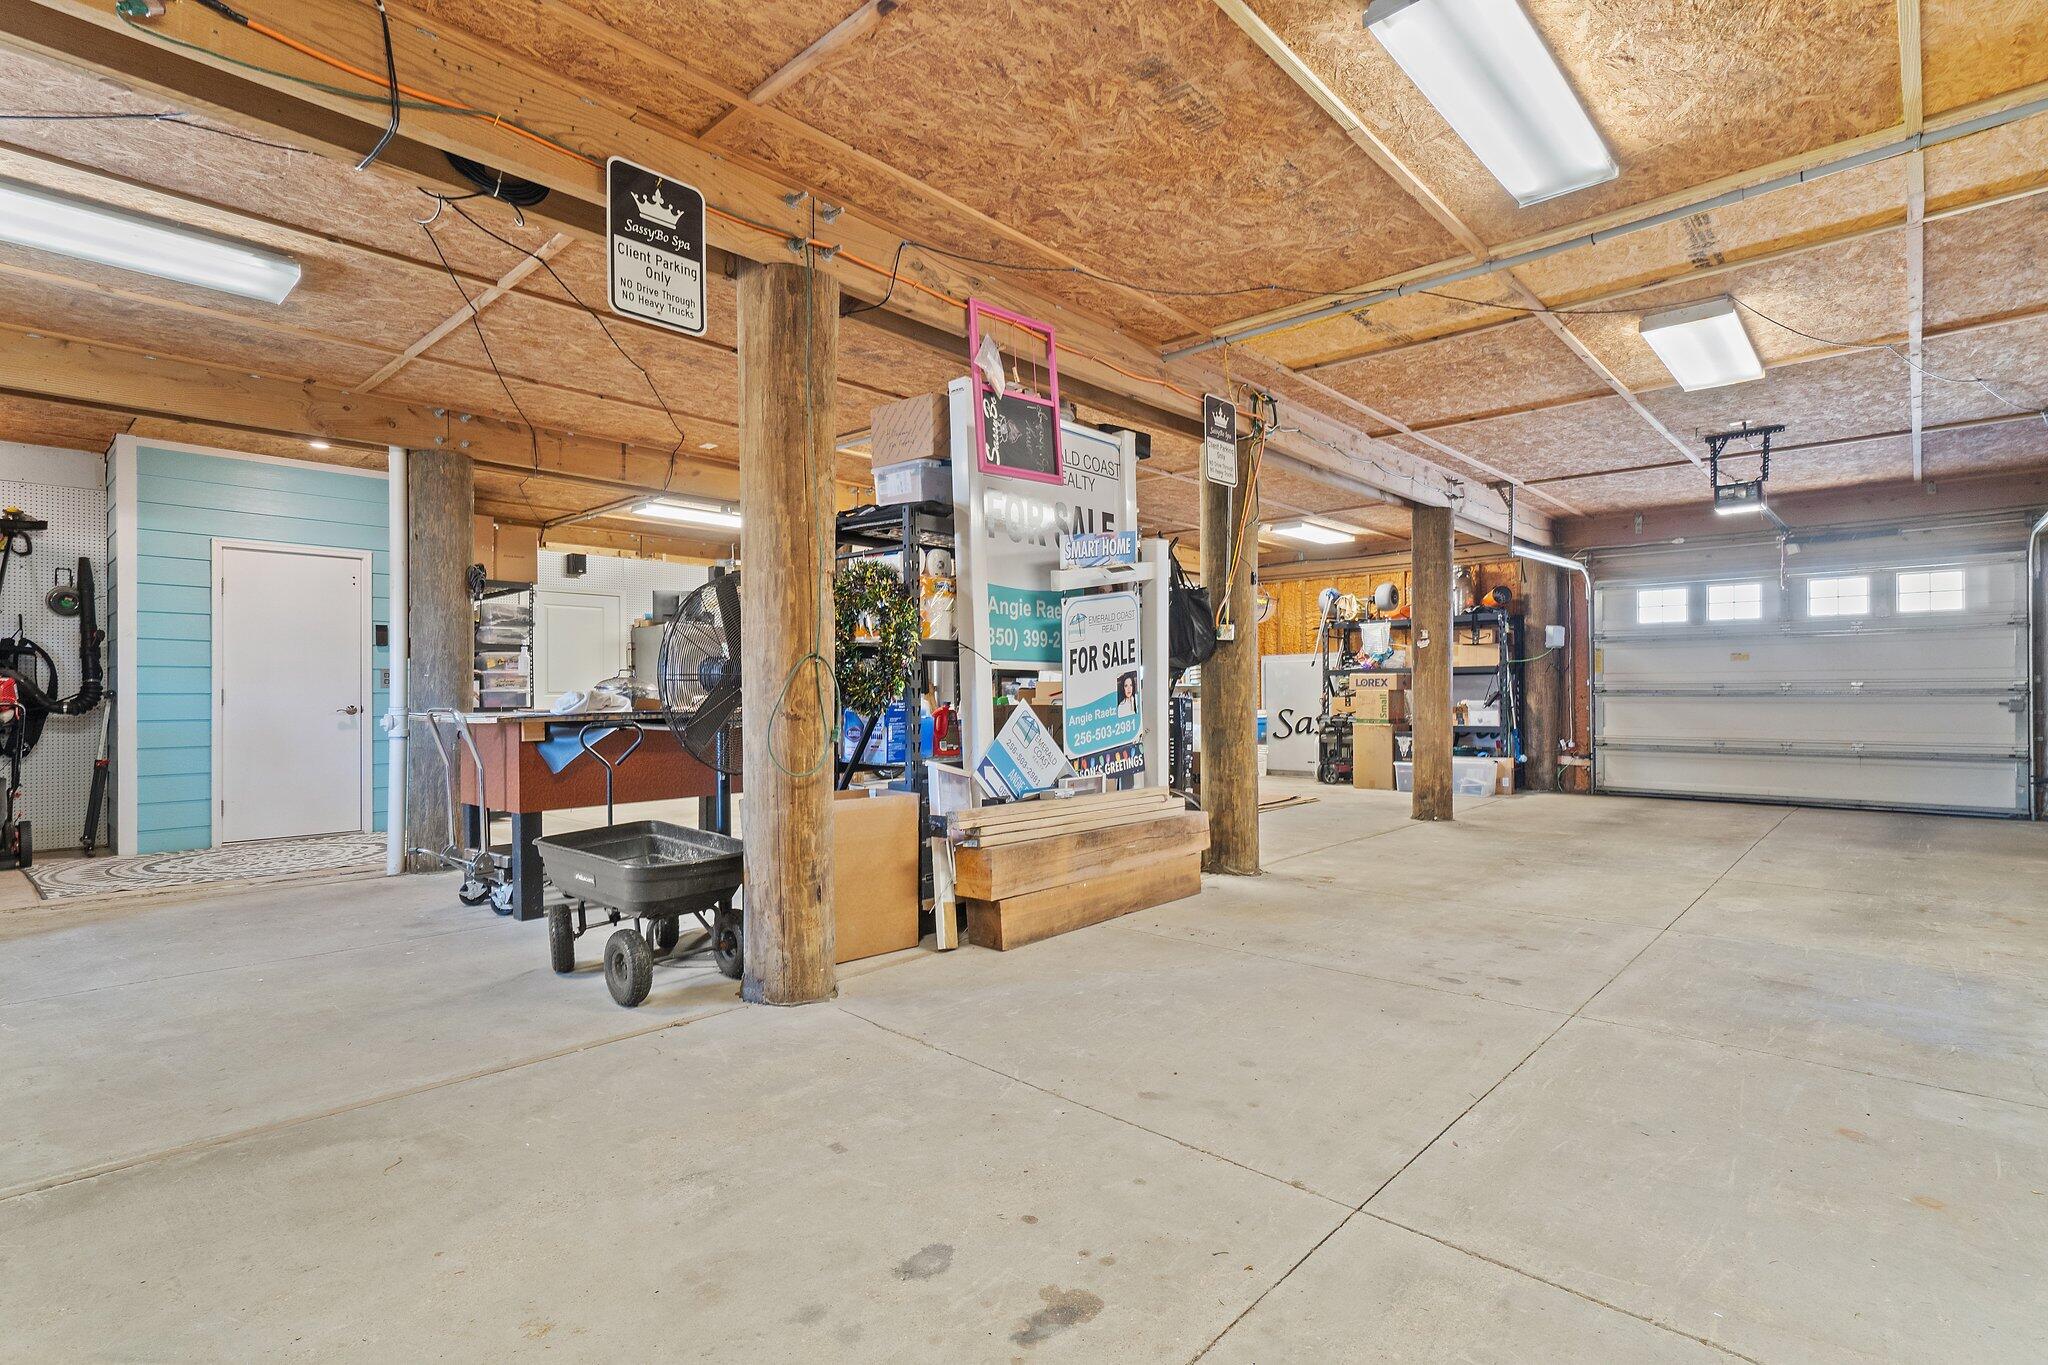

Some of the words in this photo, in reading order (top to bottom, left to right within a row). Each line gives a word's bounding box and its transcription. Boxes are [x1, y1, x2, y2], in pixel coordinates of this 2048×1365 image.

[624, 219, 669, 242] SassyBo
[671, 235, 691, 251] Spa
[617, 242, 651, 263] Client
[655, 254, 697, 282] Parking
[645, 266, 671, 286] Only
[620, 277, 633, 289] NO
[636, 282, 659, 297] Drive
[661, 290, 696, 309] Through
[622, 290, 635, 302] NO
[638, 294, 665, 312] Heavy
[667, 303, 695, 319] Trucks
[1083, 454, 1120, 478] COAST
[985, 489, 1048, 547] FOR
[1055, 501, 1115, 548] SALE
[1065, 540, 1100, 560] SMART
[1102, 537, 1131, 556] HOME
[988, 596, 1032, 620] Angie
[1088, 612, 1116, 624] EMERALD
[1116, 610, 1135, 620] COAST
[1101, 623, 1123, 633] REALTY
[1069, 645, 1098, 676] FOR
[1102, 638, 1136, 669] SALE
[1355, 678, 1388, 687] LOREX
[1068, 711, 1093, 726] Angie
[1094, 707, 1117, 720] Raetz
[1379, 694, 1387, 718] Small
[1073, 719, 1136, 747] 256-503-2981
[1272, 708, 1320, 739] Sa
[1033, 746, 1051, 768] COAST
[1034, 734, 1058, 766] EMERALD
[1104, 754, 1144, 775] GREETINGS
